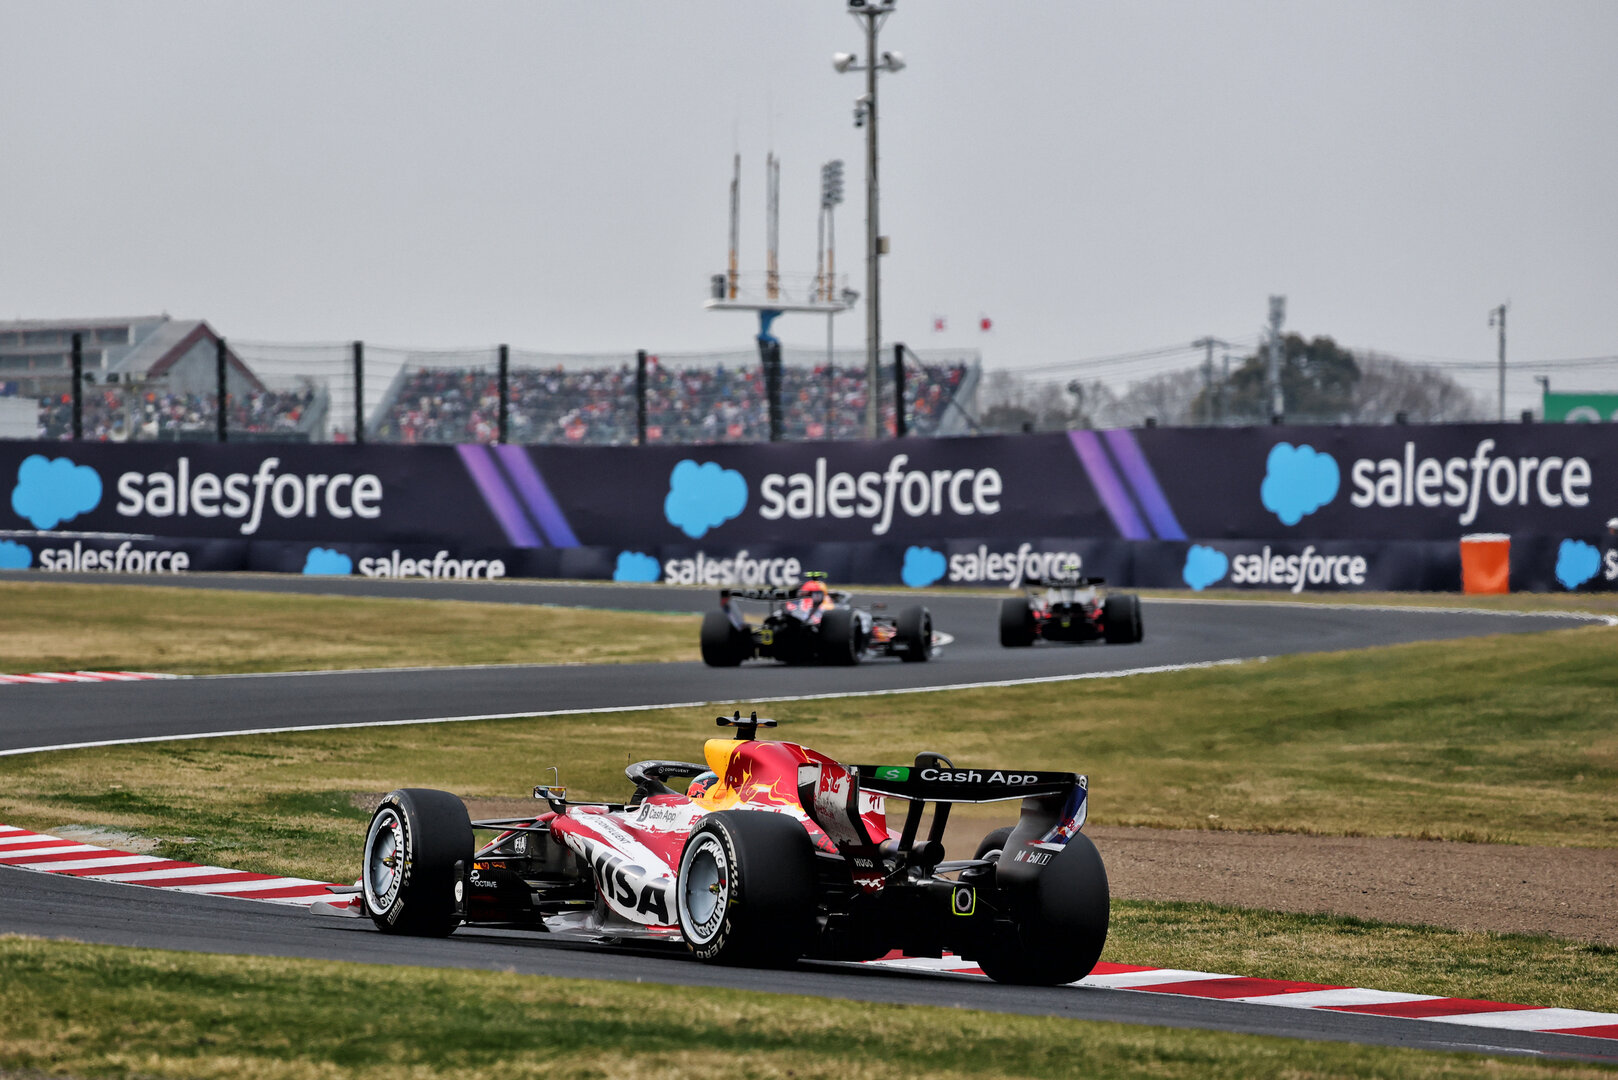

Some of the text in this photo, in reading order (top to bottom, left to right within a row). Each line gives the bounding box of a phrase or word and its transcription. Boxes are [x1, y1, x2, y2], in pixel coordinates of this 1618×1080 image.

[116, 456, 383, 535] salesforce
[759, 453, 1002, 535] salesforce
[1350, 438, 1592, 526] salesforce
[39, 541, 190, 573] salesforce
[358, 549, 506, 580] salesforce
[664, 549, 801, 585] salesforce
[949, 542, 1082, 590] salesforce
[1231, 545, 1367, 595] salesforce
[920, 768, 1038, 786] Cash App
[648, 808, 662, 819] Cash
[662, 809, 677, 823] App
[854, 857, 874, 869] HUGO
[1014, 849, 1042, 864] Mobil
[474, 880, 498, 888] OCTAVE
[580, 838, 670, 925] VISA
